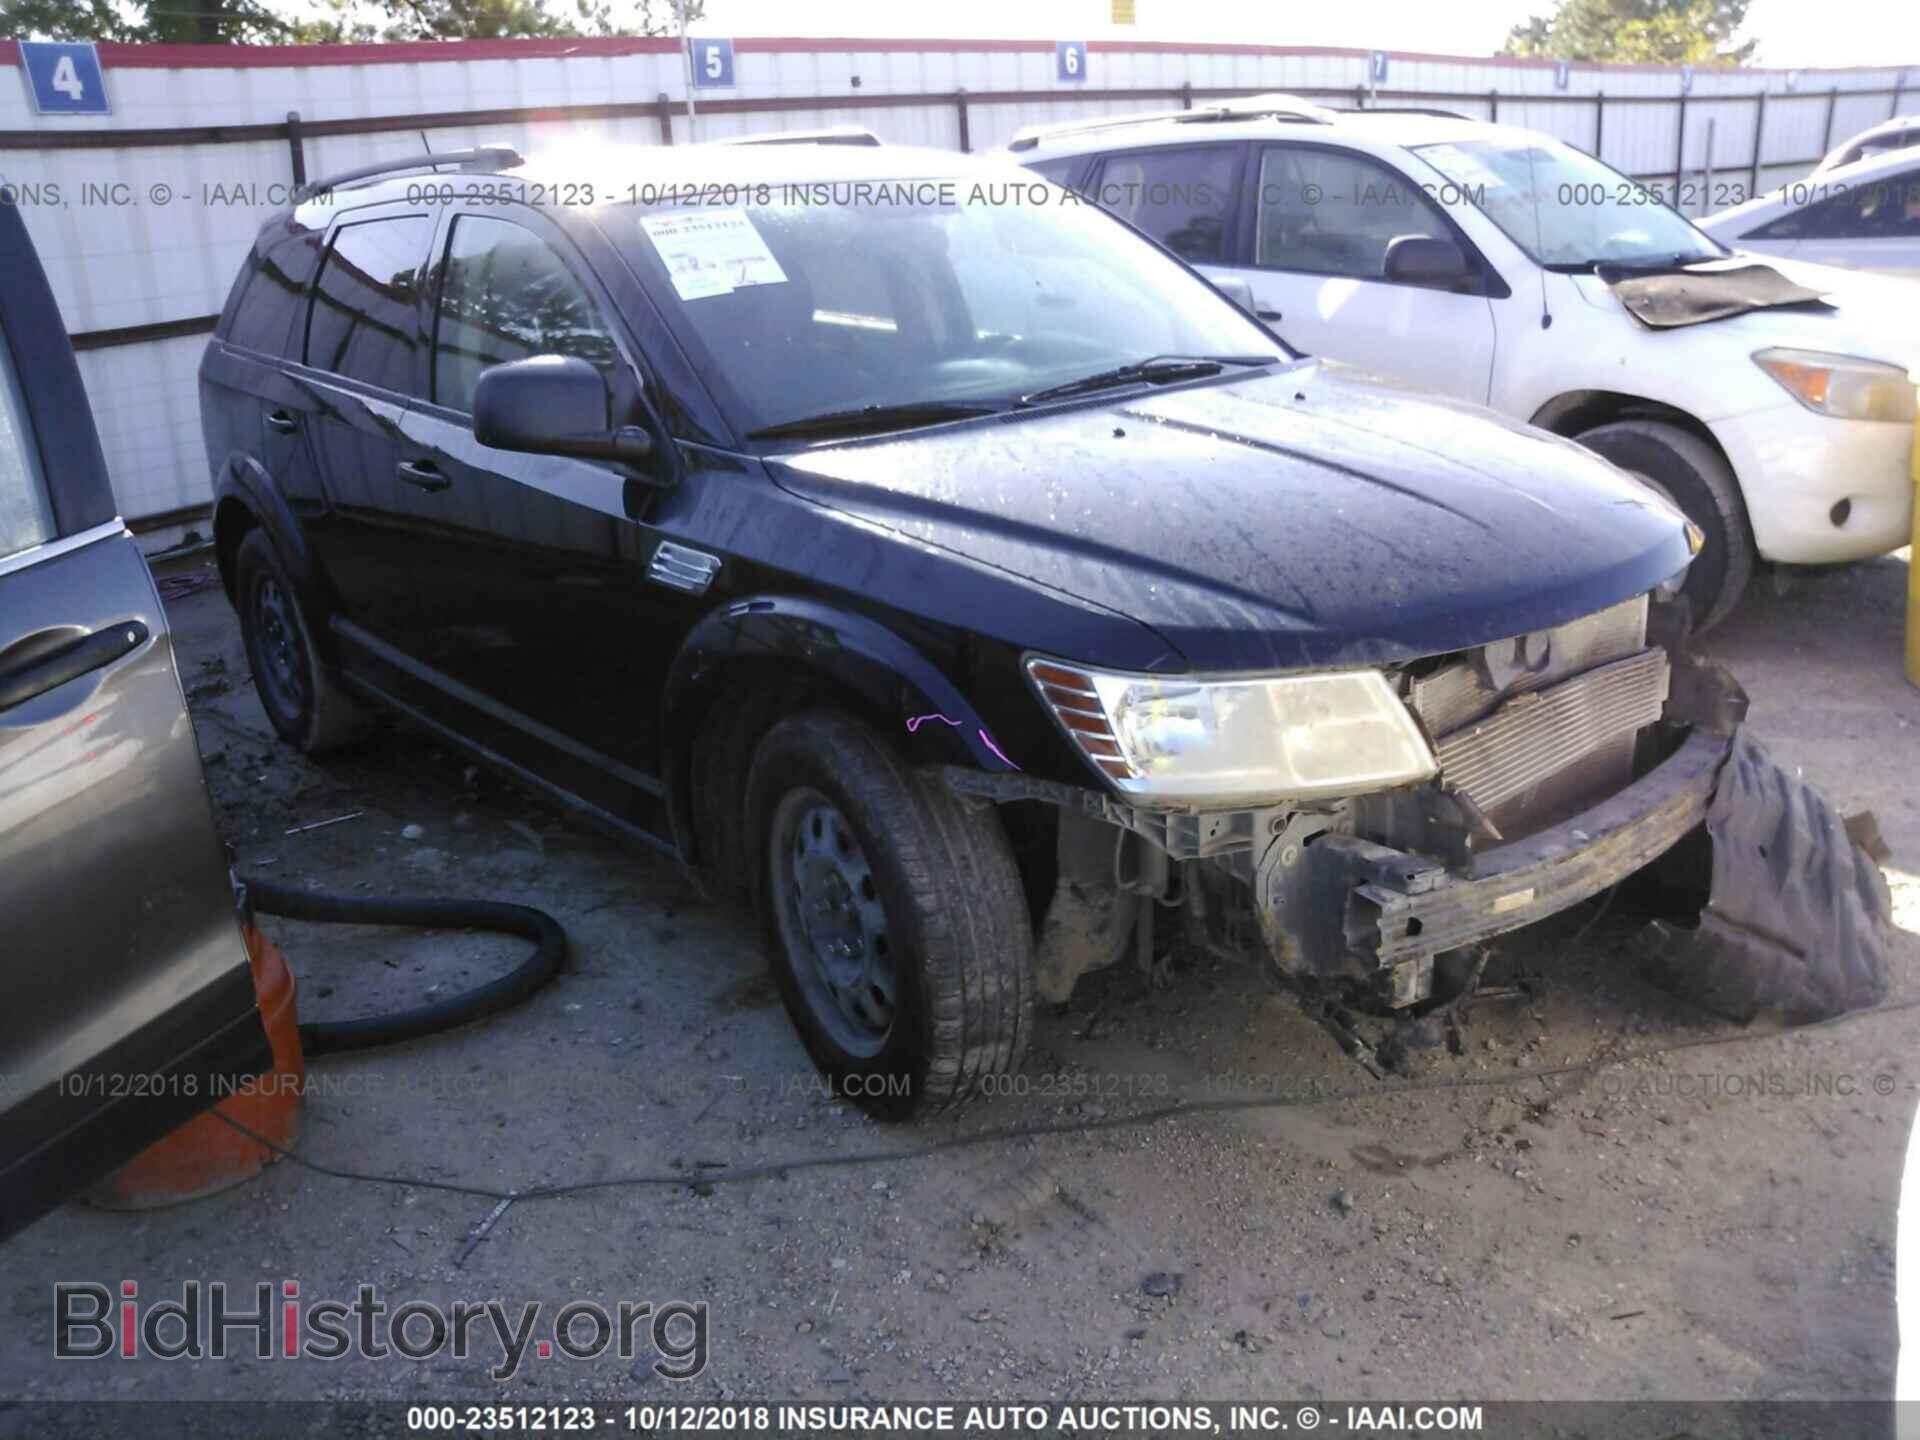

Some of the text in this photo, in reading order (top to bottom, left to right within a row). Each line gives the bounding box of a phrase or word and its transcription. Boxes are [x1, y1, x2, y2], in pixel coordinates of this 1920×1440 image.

[705, 46, 722, 79] 5
[1065, 46, 1078, 74] 6
[52, 55, 83, 100] 4
